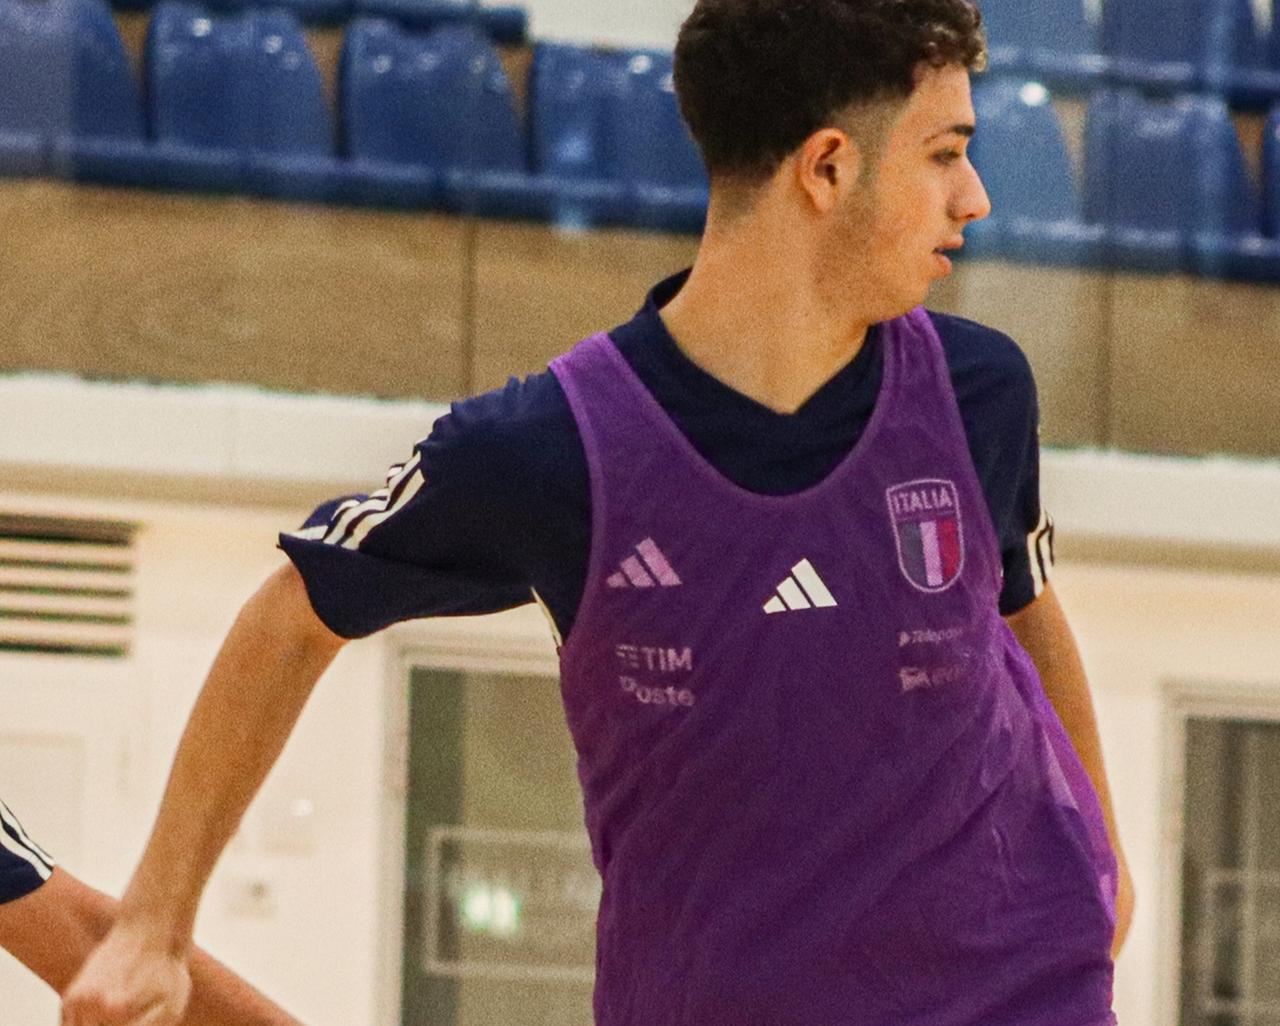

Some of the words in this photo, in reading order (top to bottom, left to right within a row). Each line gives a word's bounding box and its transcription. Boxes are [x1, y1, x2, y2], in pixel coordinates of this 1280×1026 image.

[891, 486, 954, 514] ITALIA
[640, 646, 694, 671] TIM
[618, 674, 696, 708] Poste
